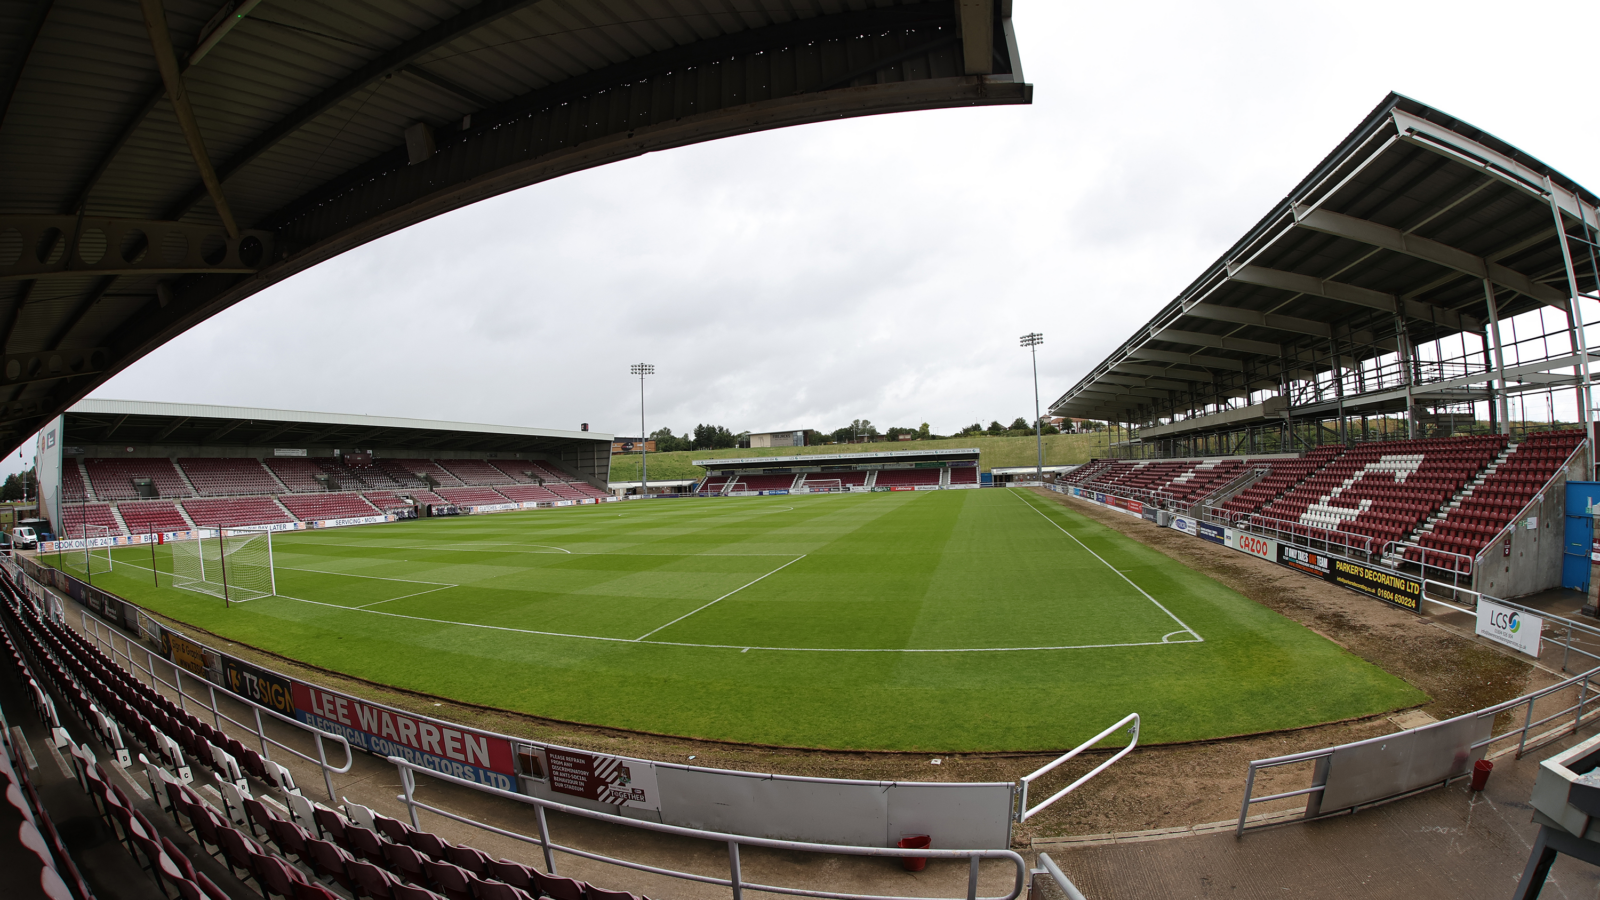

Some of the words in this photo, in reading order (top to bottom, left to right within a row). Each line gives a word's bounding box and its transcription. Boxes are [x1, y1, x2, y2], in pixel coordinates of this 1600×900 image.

[335, 518, 361, 526] SERVICING
[144, 533, 170, 542] BRAES
[54, 540, 74, 549] BOOK
[1240, 535, 1268, 556] CAZOO
[1336, 560, 1364, 577] PARKER'S
[1364, 569, 1406, 590] DECORATING
[1406, 581, 1420, 594] LTD
[1377, 588, 1394, 600] 01604
[1394, 593, 1416, 608] 630224
[1490, 610, 1508, 630] LCS
[309, 688, 351, 725] LEE
[354, 702, 490, 768] WARREN
[305, 712, 368, 749] ELECTRICAL
[371, 736, 476, 782] CONTRACTORS
[479, 769, 511, 792] LTD
[566, 756, 585, 764] REFRAIN
[552, 765, 589, 776] DISCRIMINATORY
[554, 776, 578, 785] BEHAVIOUR
[560, 772, 587, 781] ANTI-SOCIAL
[611, 790, 645, 802] TOGETHER
